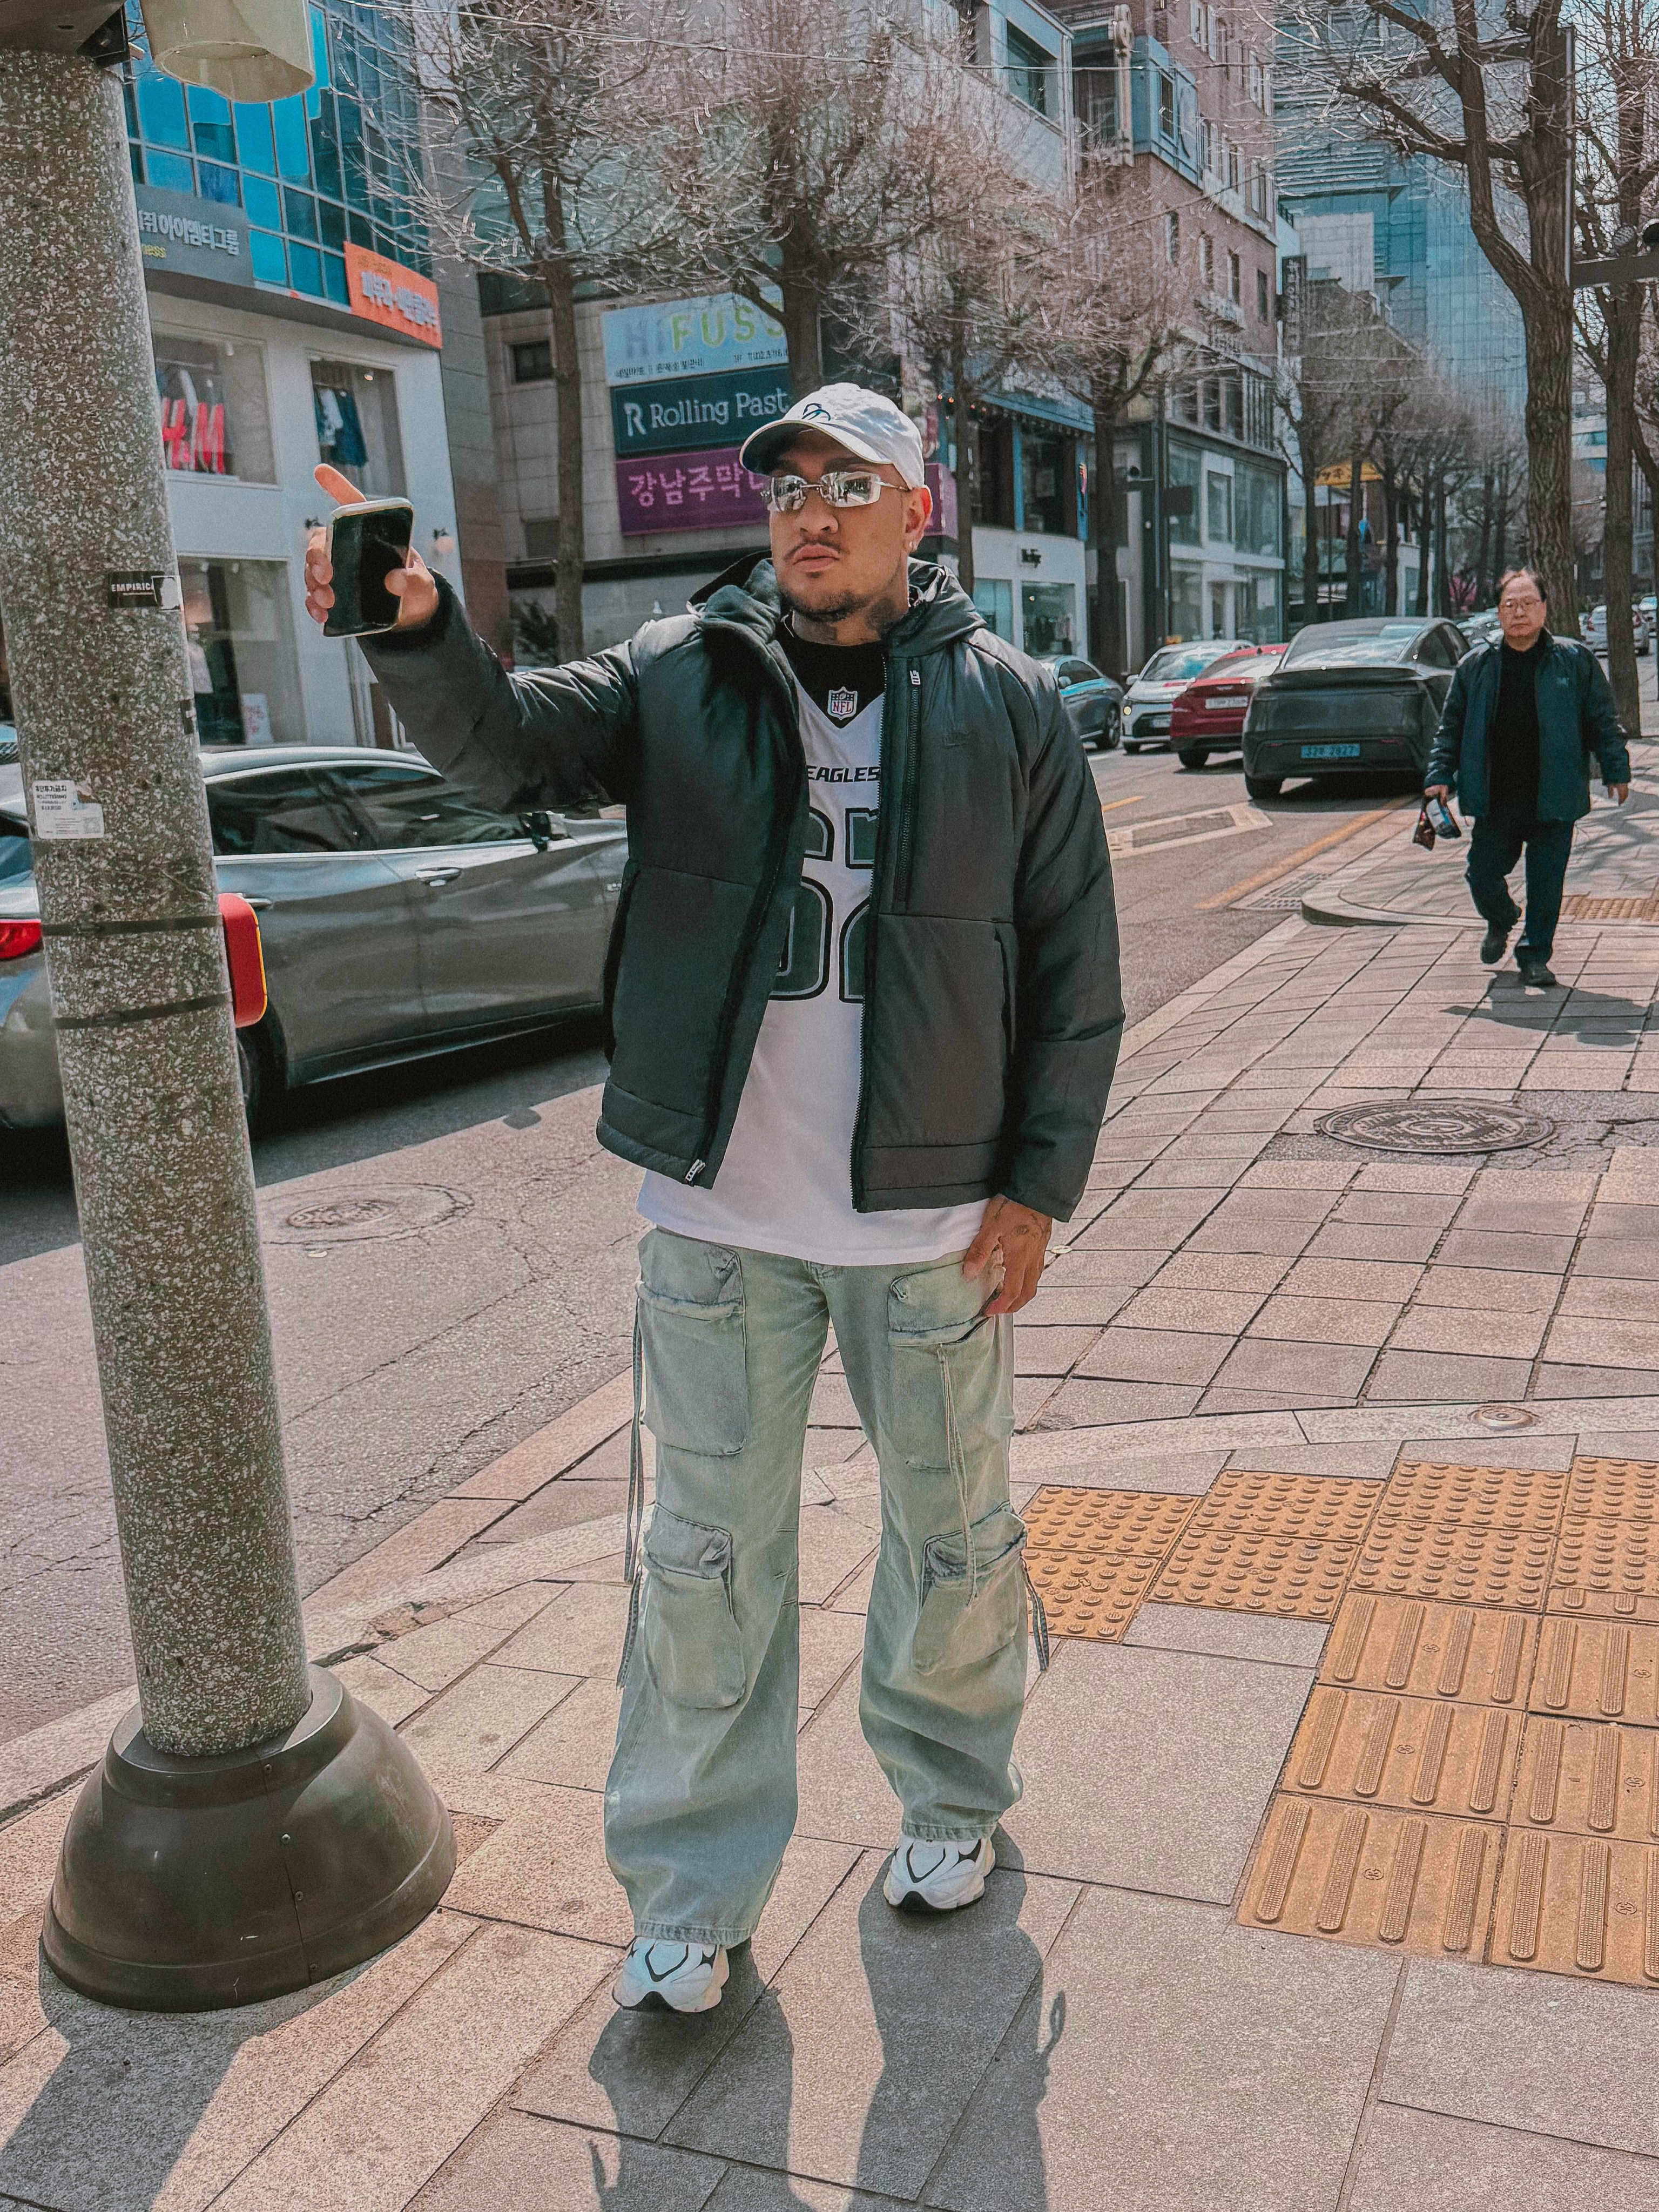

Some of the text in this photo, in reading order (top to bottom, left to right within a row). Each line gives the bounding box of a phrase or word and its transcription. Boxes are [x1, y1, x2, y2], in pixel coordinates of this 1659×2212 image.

[649, 399, 729, 428] Rolling
[735, 387, 791, 418] Past
[833, 701, 852, 713] NFL
[806, 765, 881, 783] EAGLES
